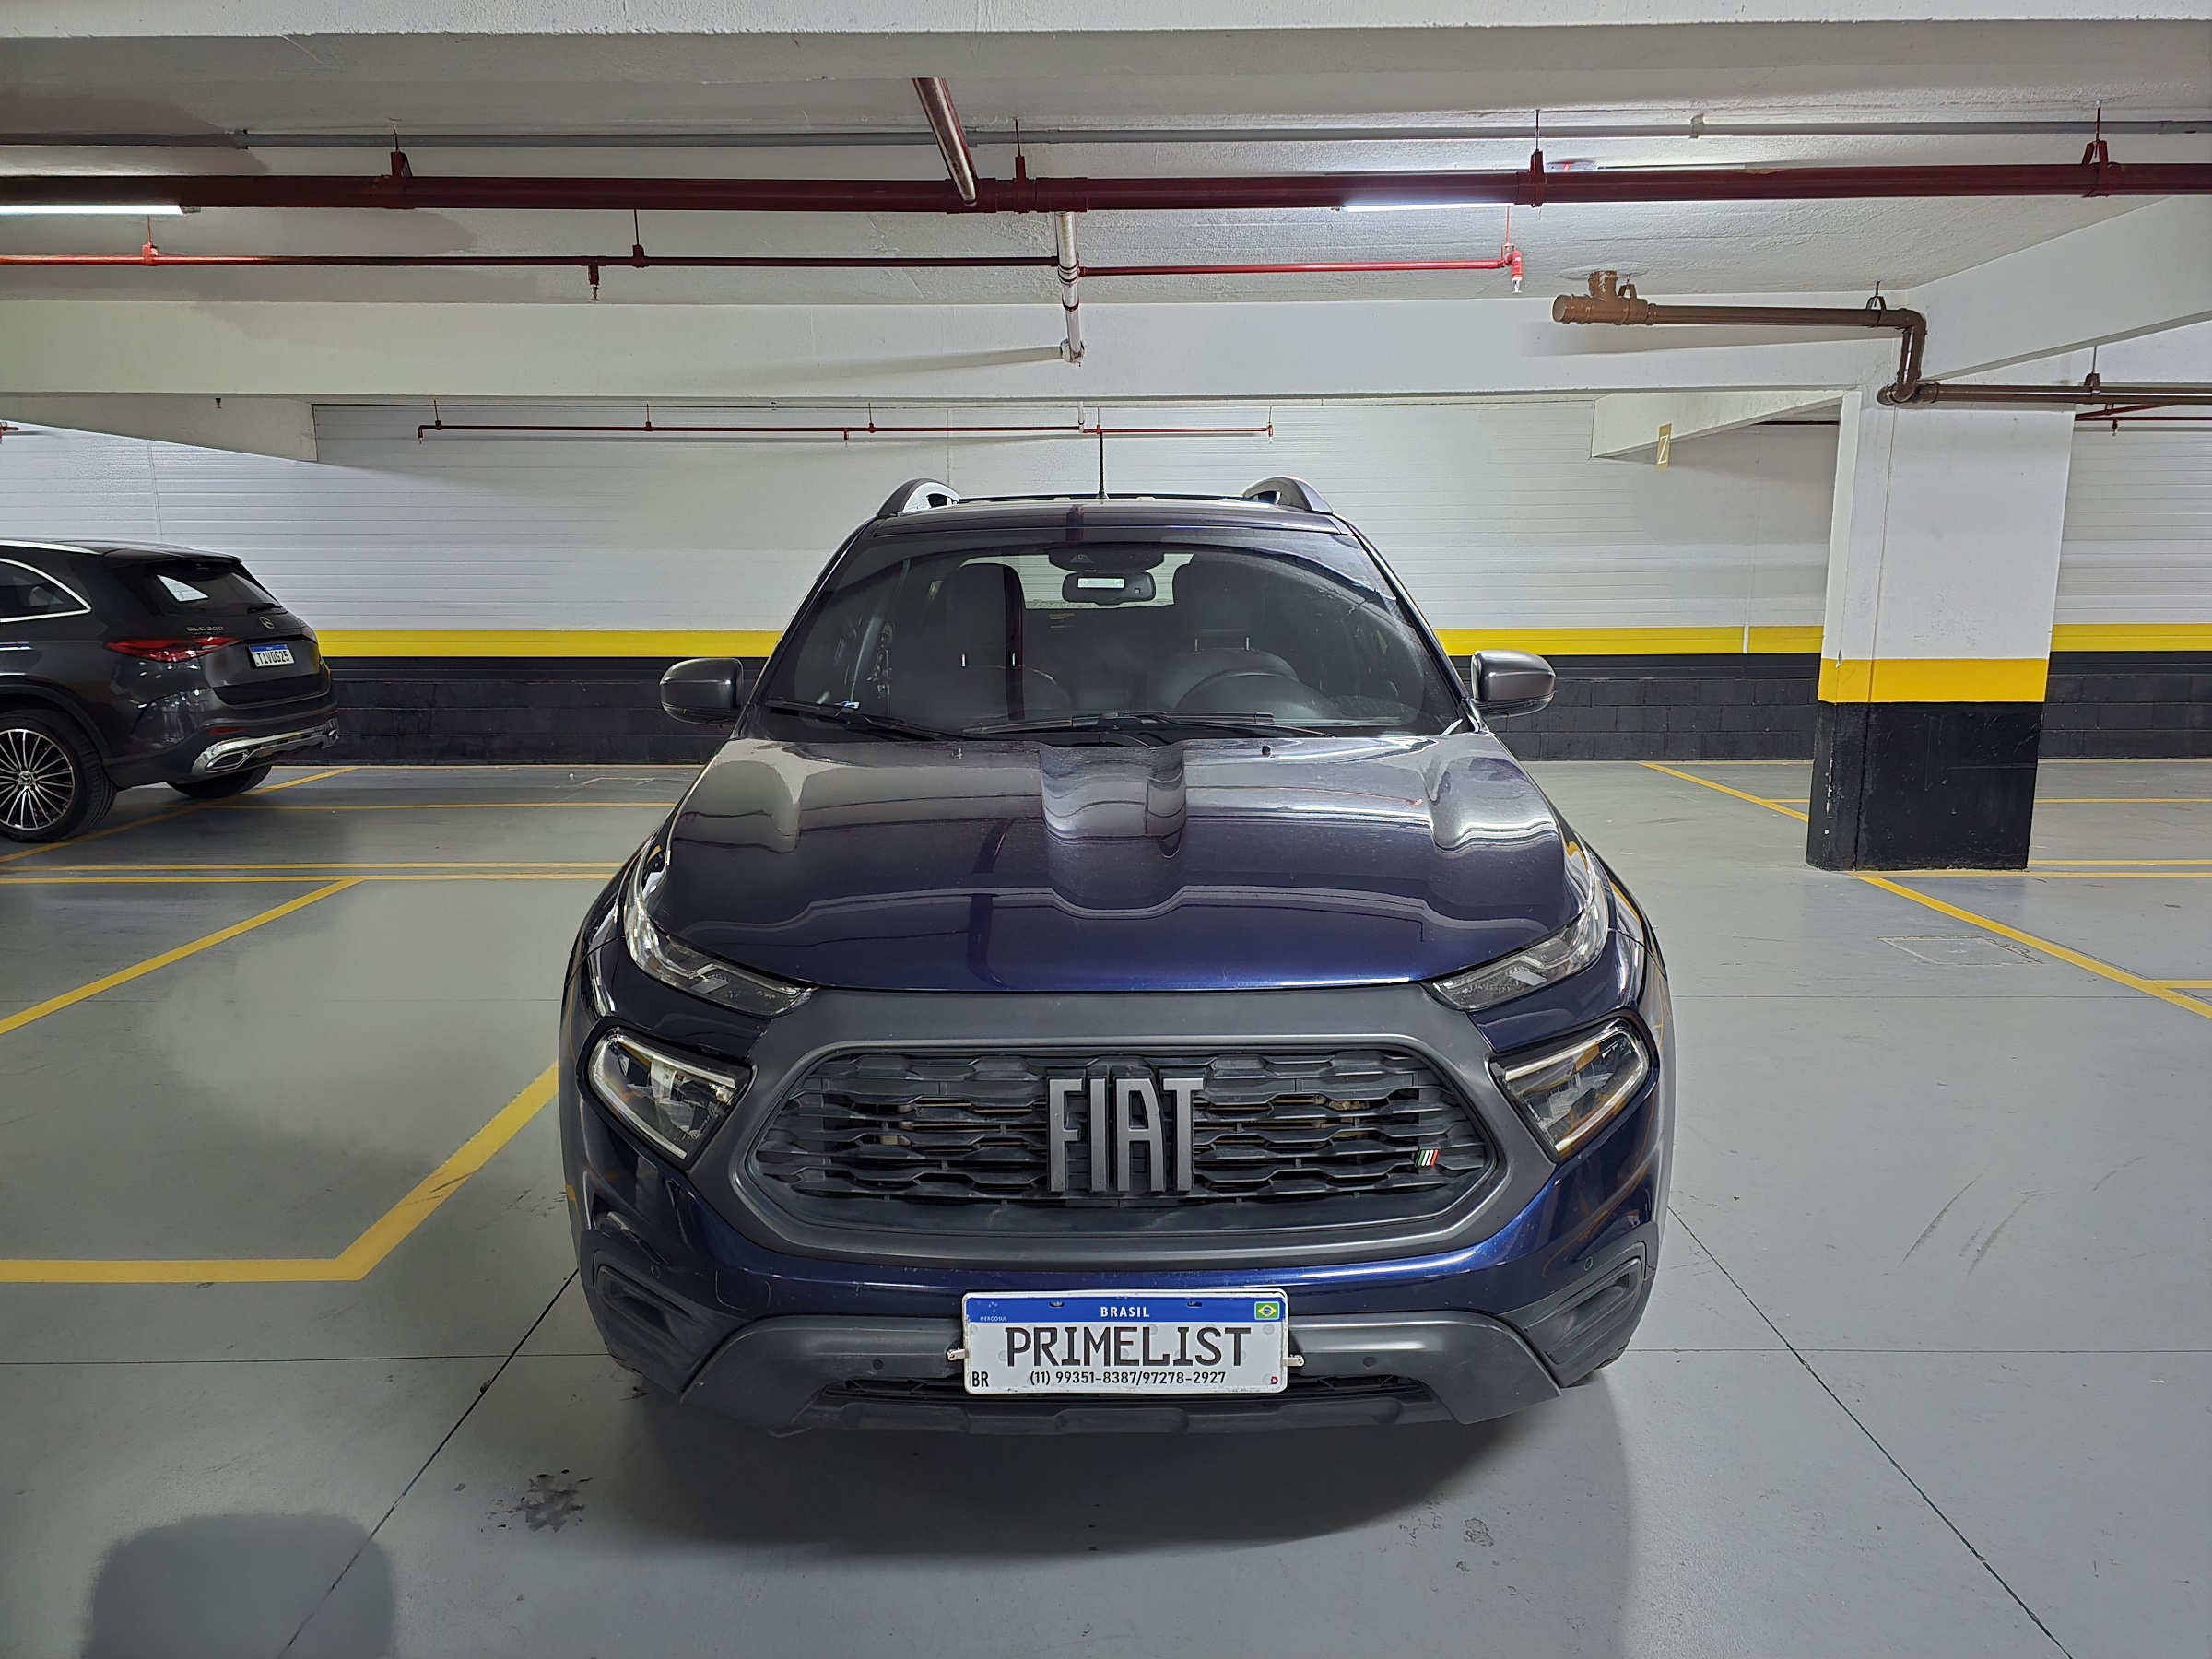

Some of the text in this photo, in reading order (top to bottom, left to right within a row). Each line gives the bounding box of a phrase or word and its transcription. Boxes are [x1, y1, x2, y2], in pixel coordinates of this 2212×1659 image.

[1049, 1077, 1205, 1192] FIAT
[1100, 1306, 1150, 1318] BRASIL
[1005, 1326, 1252, 1367] PRIMELIST
[971, 1371, 989, 1388] BR
[1030, 1371, 1226, 1385] (11) 99351-8387/97278-2927
